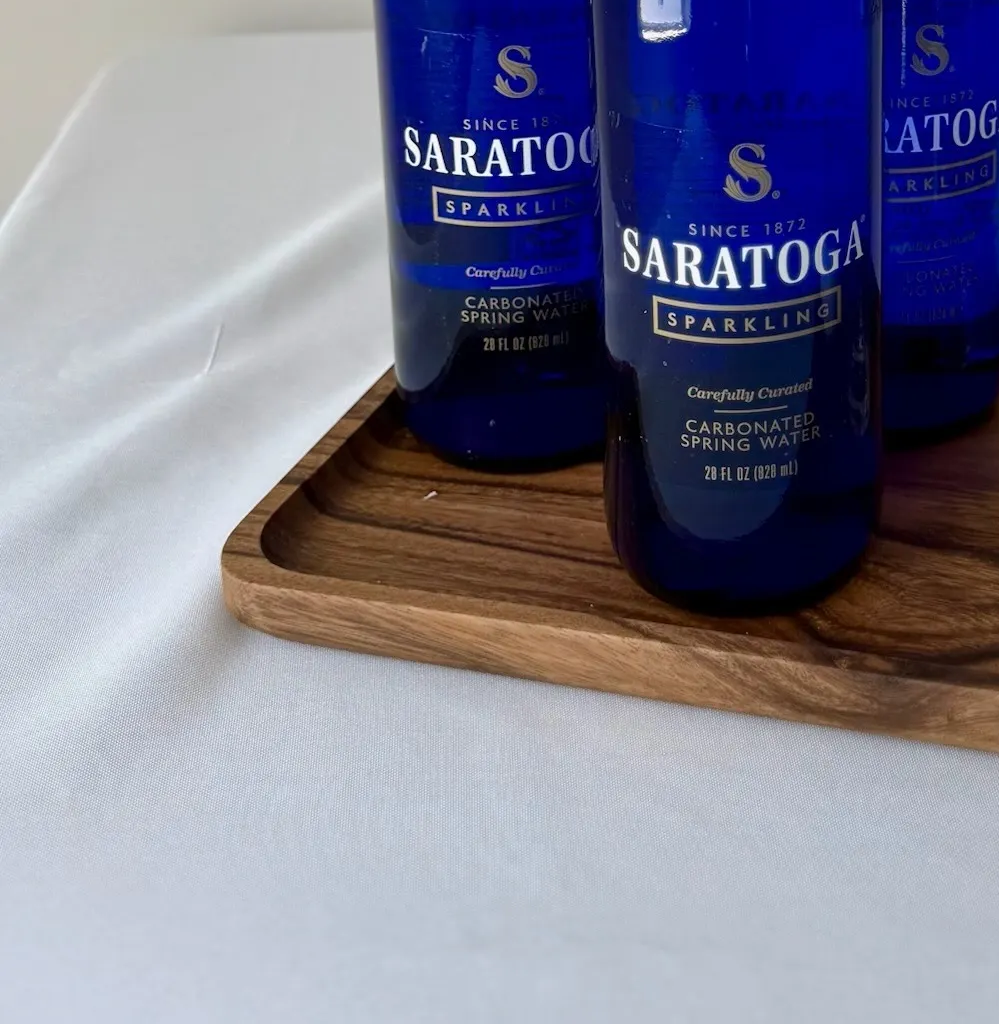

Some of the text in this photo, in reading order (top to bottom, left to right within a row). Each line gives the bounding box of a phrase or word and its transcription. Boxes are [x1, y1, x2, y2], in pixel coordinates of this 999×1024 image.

[889, 89, 974, 109] INCE 1872
[463, 117, 519, 131] SINCE
[404, 126, 596, 177] SARATO
[889, 164, 989, 193] ARKLING
[445, 196, 577, 217] SPARKLI
[688, 219, 806, 237] SINCE 1872
[622, 220, 865, 289] SARATOGA
[465, 266, 527, 281] Carefully
[461, 310, 525, 324] SPRING
[667, 301, 830, 333] SPARKLING
[498, 337, 509, 351] FL
[512, 336, 525, 351] OZ
[687, 378, 813, 403] Carefully Curated
[685, 412, 815, 436] CARBONATED
[680, 426, 821, 451] SPRING WATER
[704, 459, 798, 482] 28 FL OZ (828 mL)
